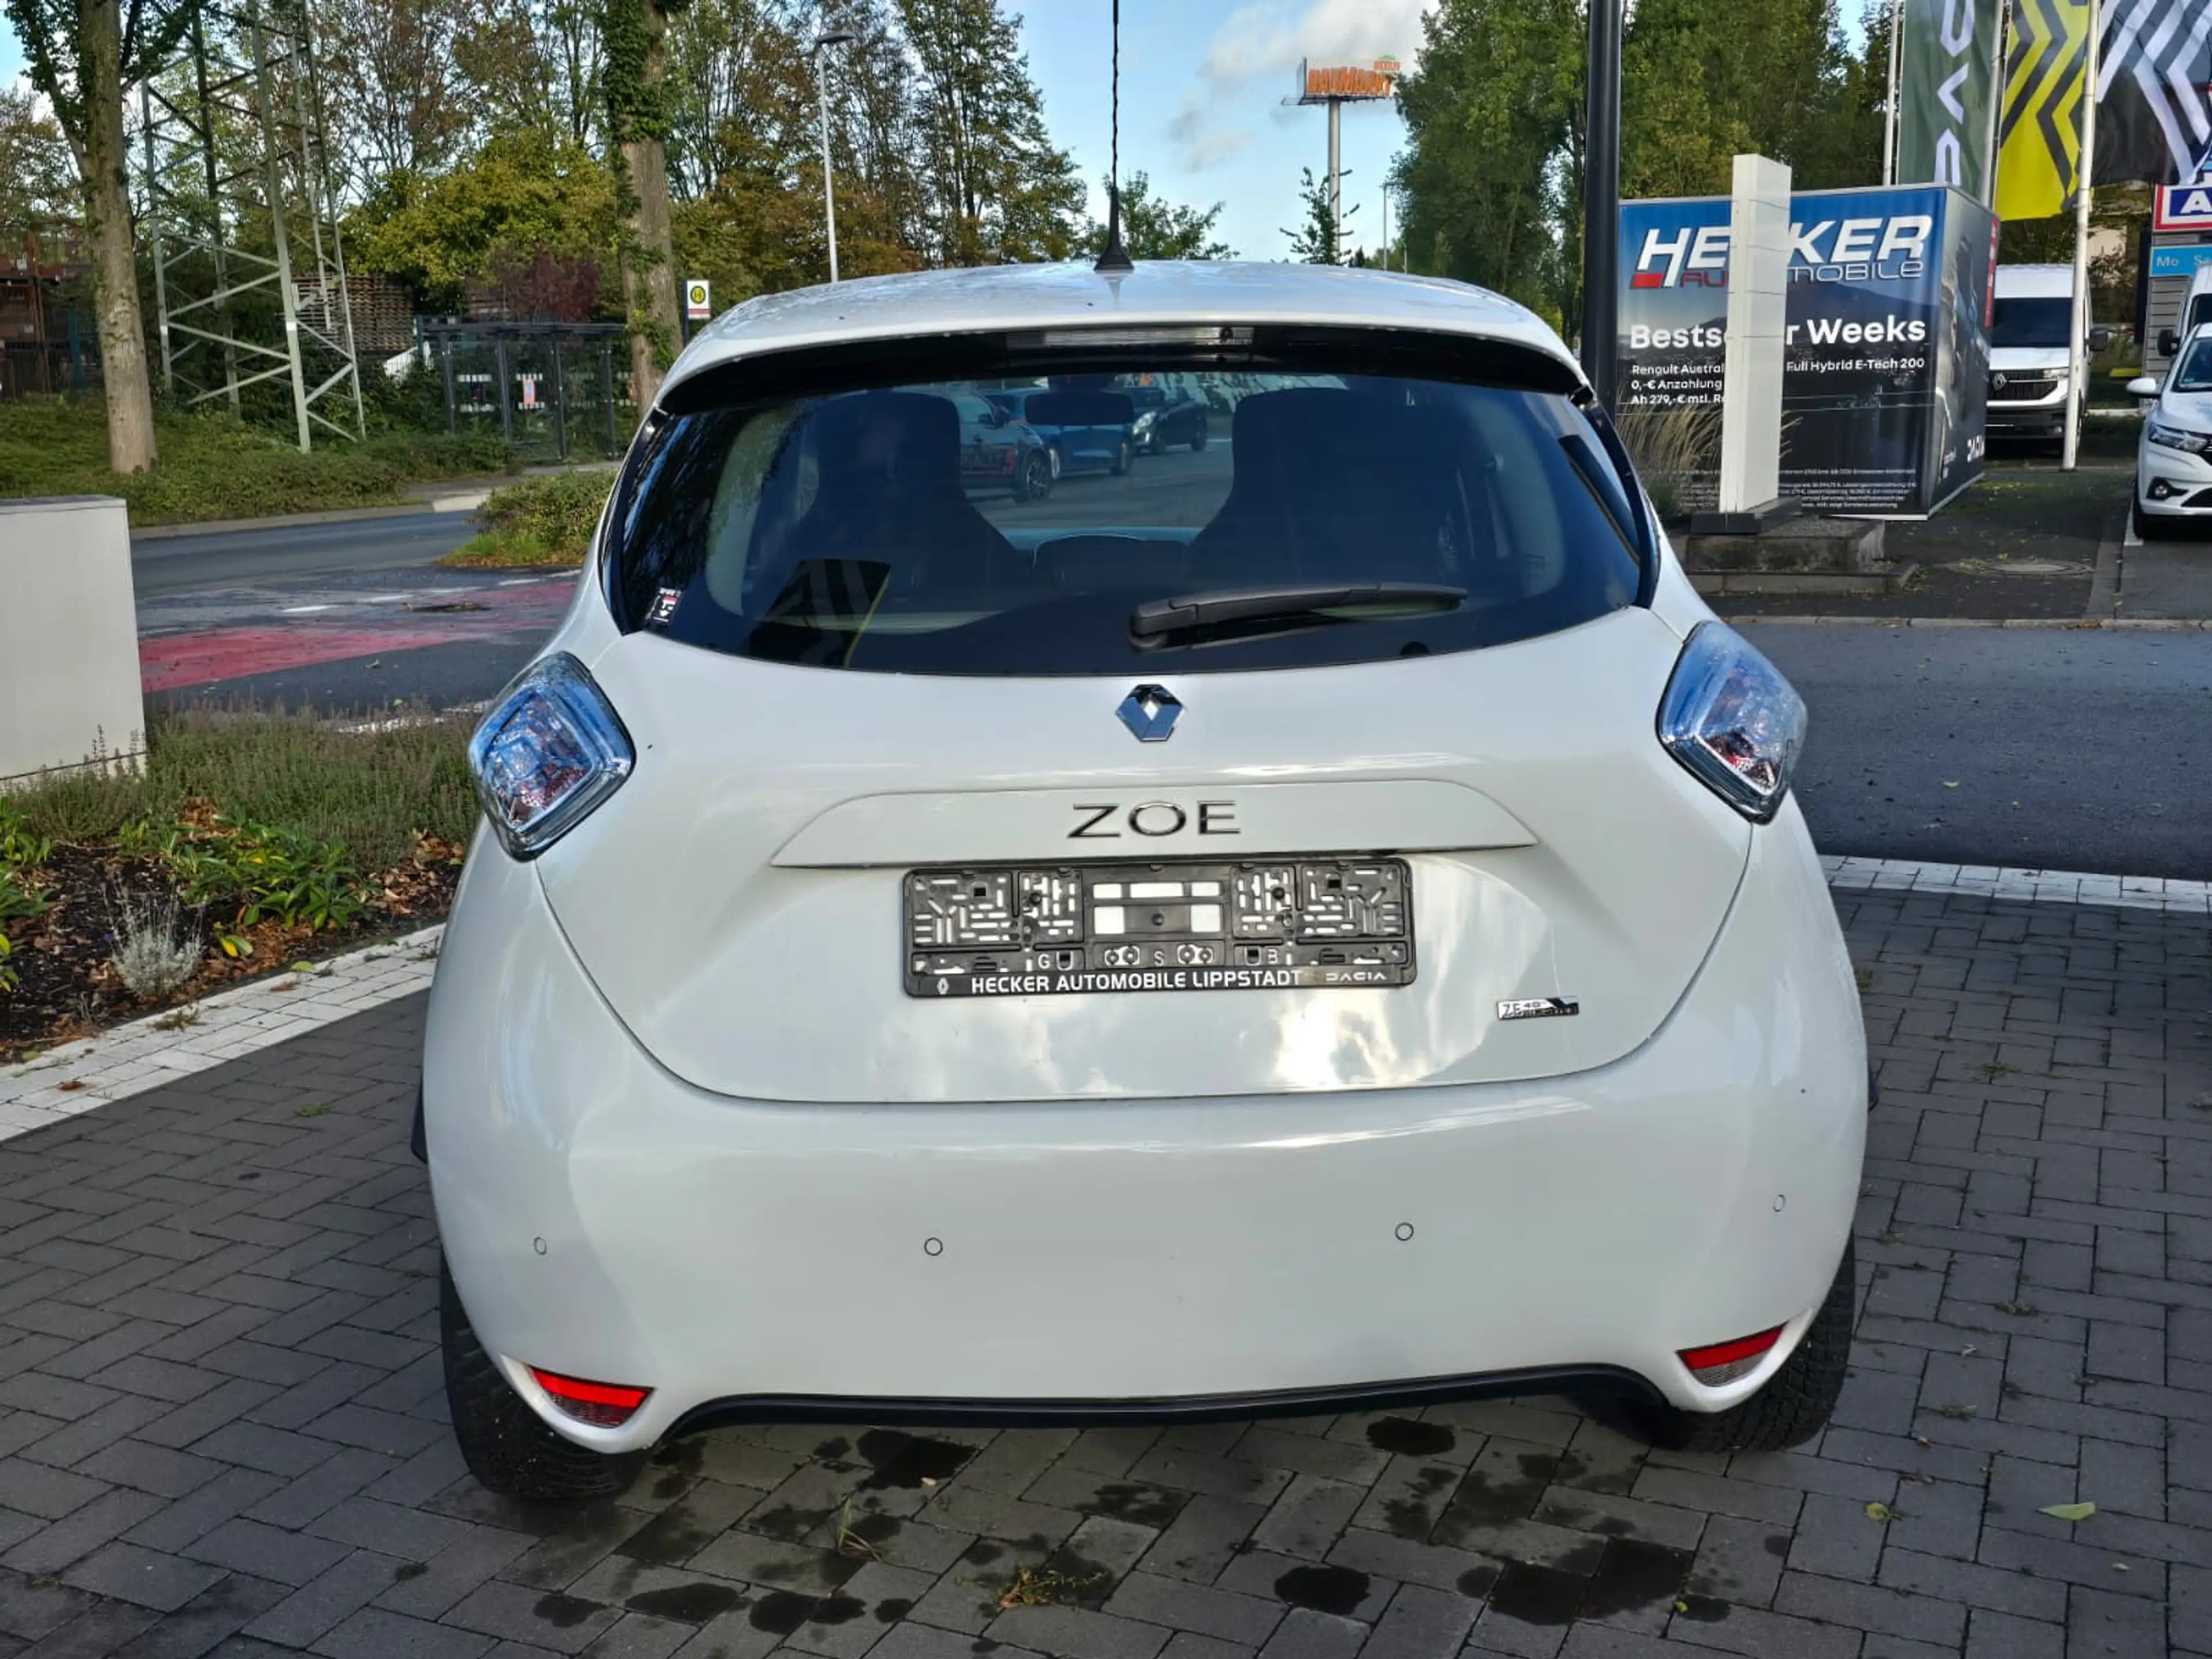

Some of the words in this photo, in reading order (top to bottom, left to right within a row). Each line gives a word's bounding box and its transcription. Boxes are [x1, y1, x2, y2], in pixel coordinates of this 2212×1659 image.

[1638, 215, 1933, 287] HEKER
[1681, 260, 1923, 287] AUMOBILE
[1630, 323, 1800, 349] Bestsr
[1806, 314, 1926, 344] Weeks
[1786, 361, 1808, 371] Full
[1810, 359, 1853, 373] Hybrid
[1855, 358, 1897, 370] E-Tech
[1900, 357, 1925, 369] 200
[1657, 378, 1722, 391] Anzahlung
[1066, 800, 1241, 837] ZOE
[972, 975, 1049, 994] HECKER
[1056, 972, 1185, 991] AUTOMOBILE
[1193, 970, 1302, 987] LIPPSTADT
[1326, 972, 1387, 982] DACIA
